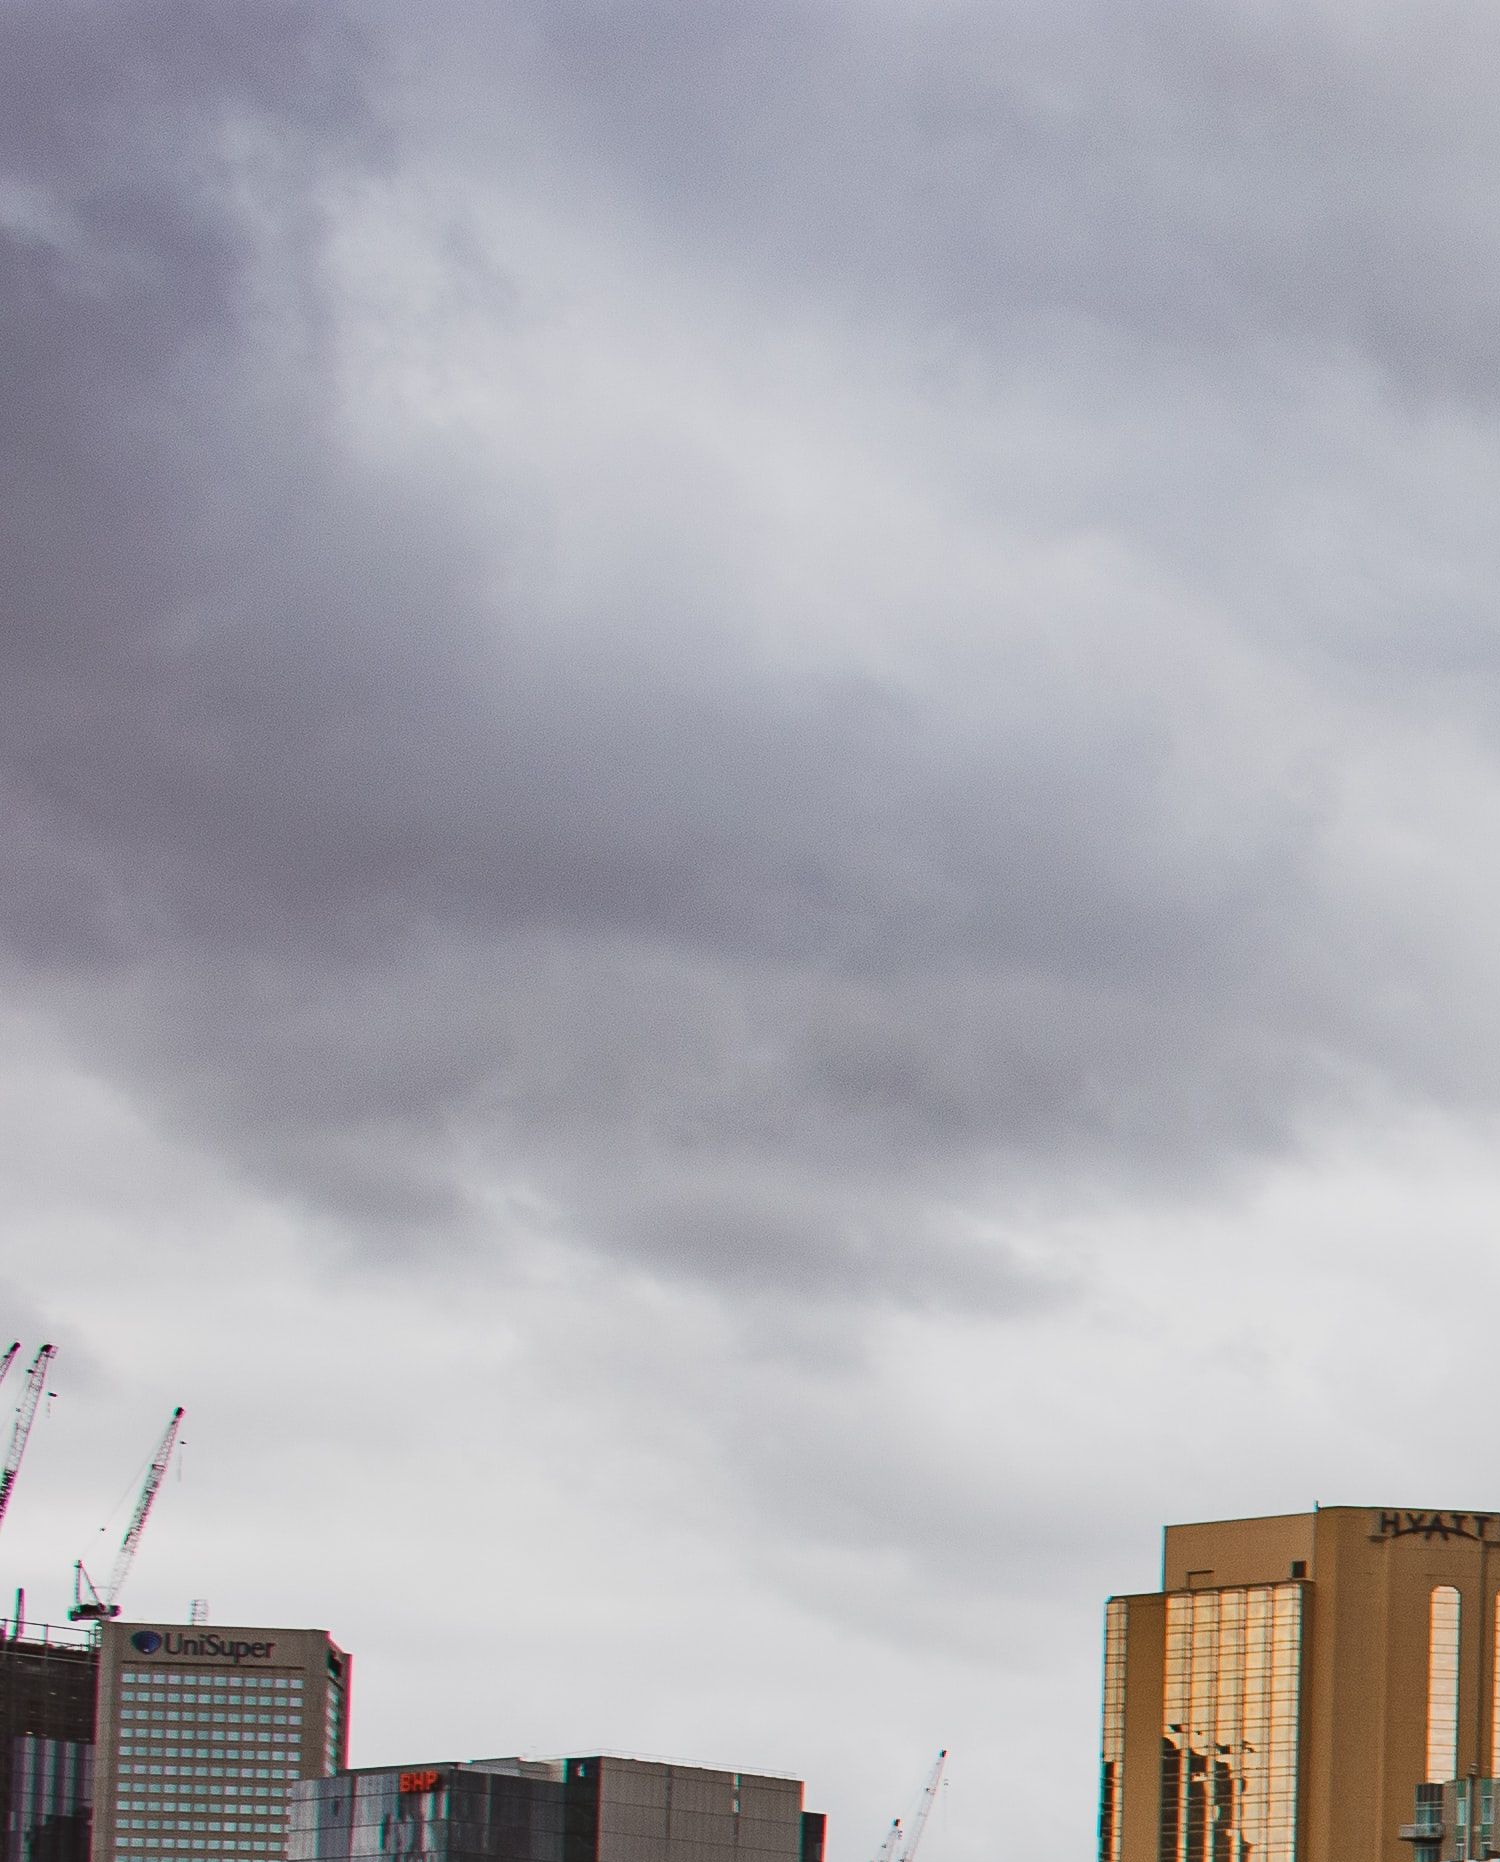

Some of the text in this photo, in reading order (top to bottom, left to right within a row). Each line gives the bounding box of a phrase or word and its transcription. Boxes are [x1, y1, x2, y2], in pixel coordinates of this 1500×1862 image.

[1380, 1511, 1490, 1540] HYATT
[165, 1632, 275, 1665] UniSuper
[400, 1770, 437, 1792] BHP
